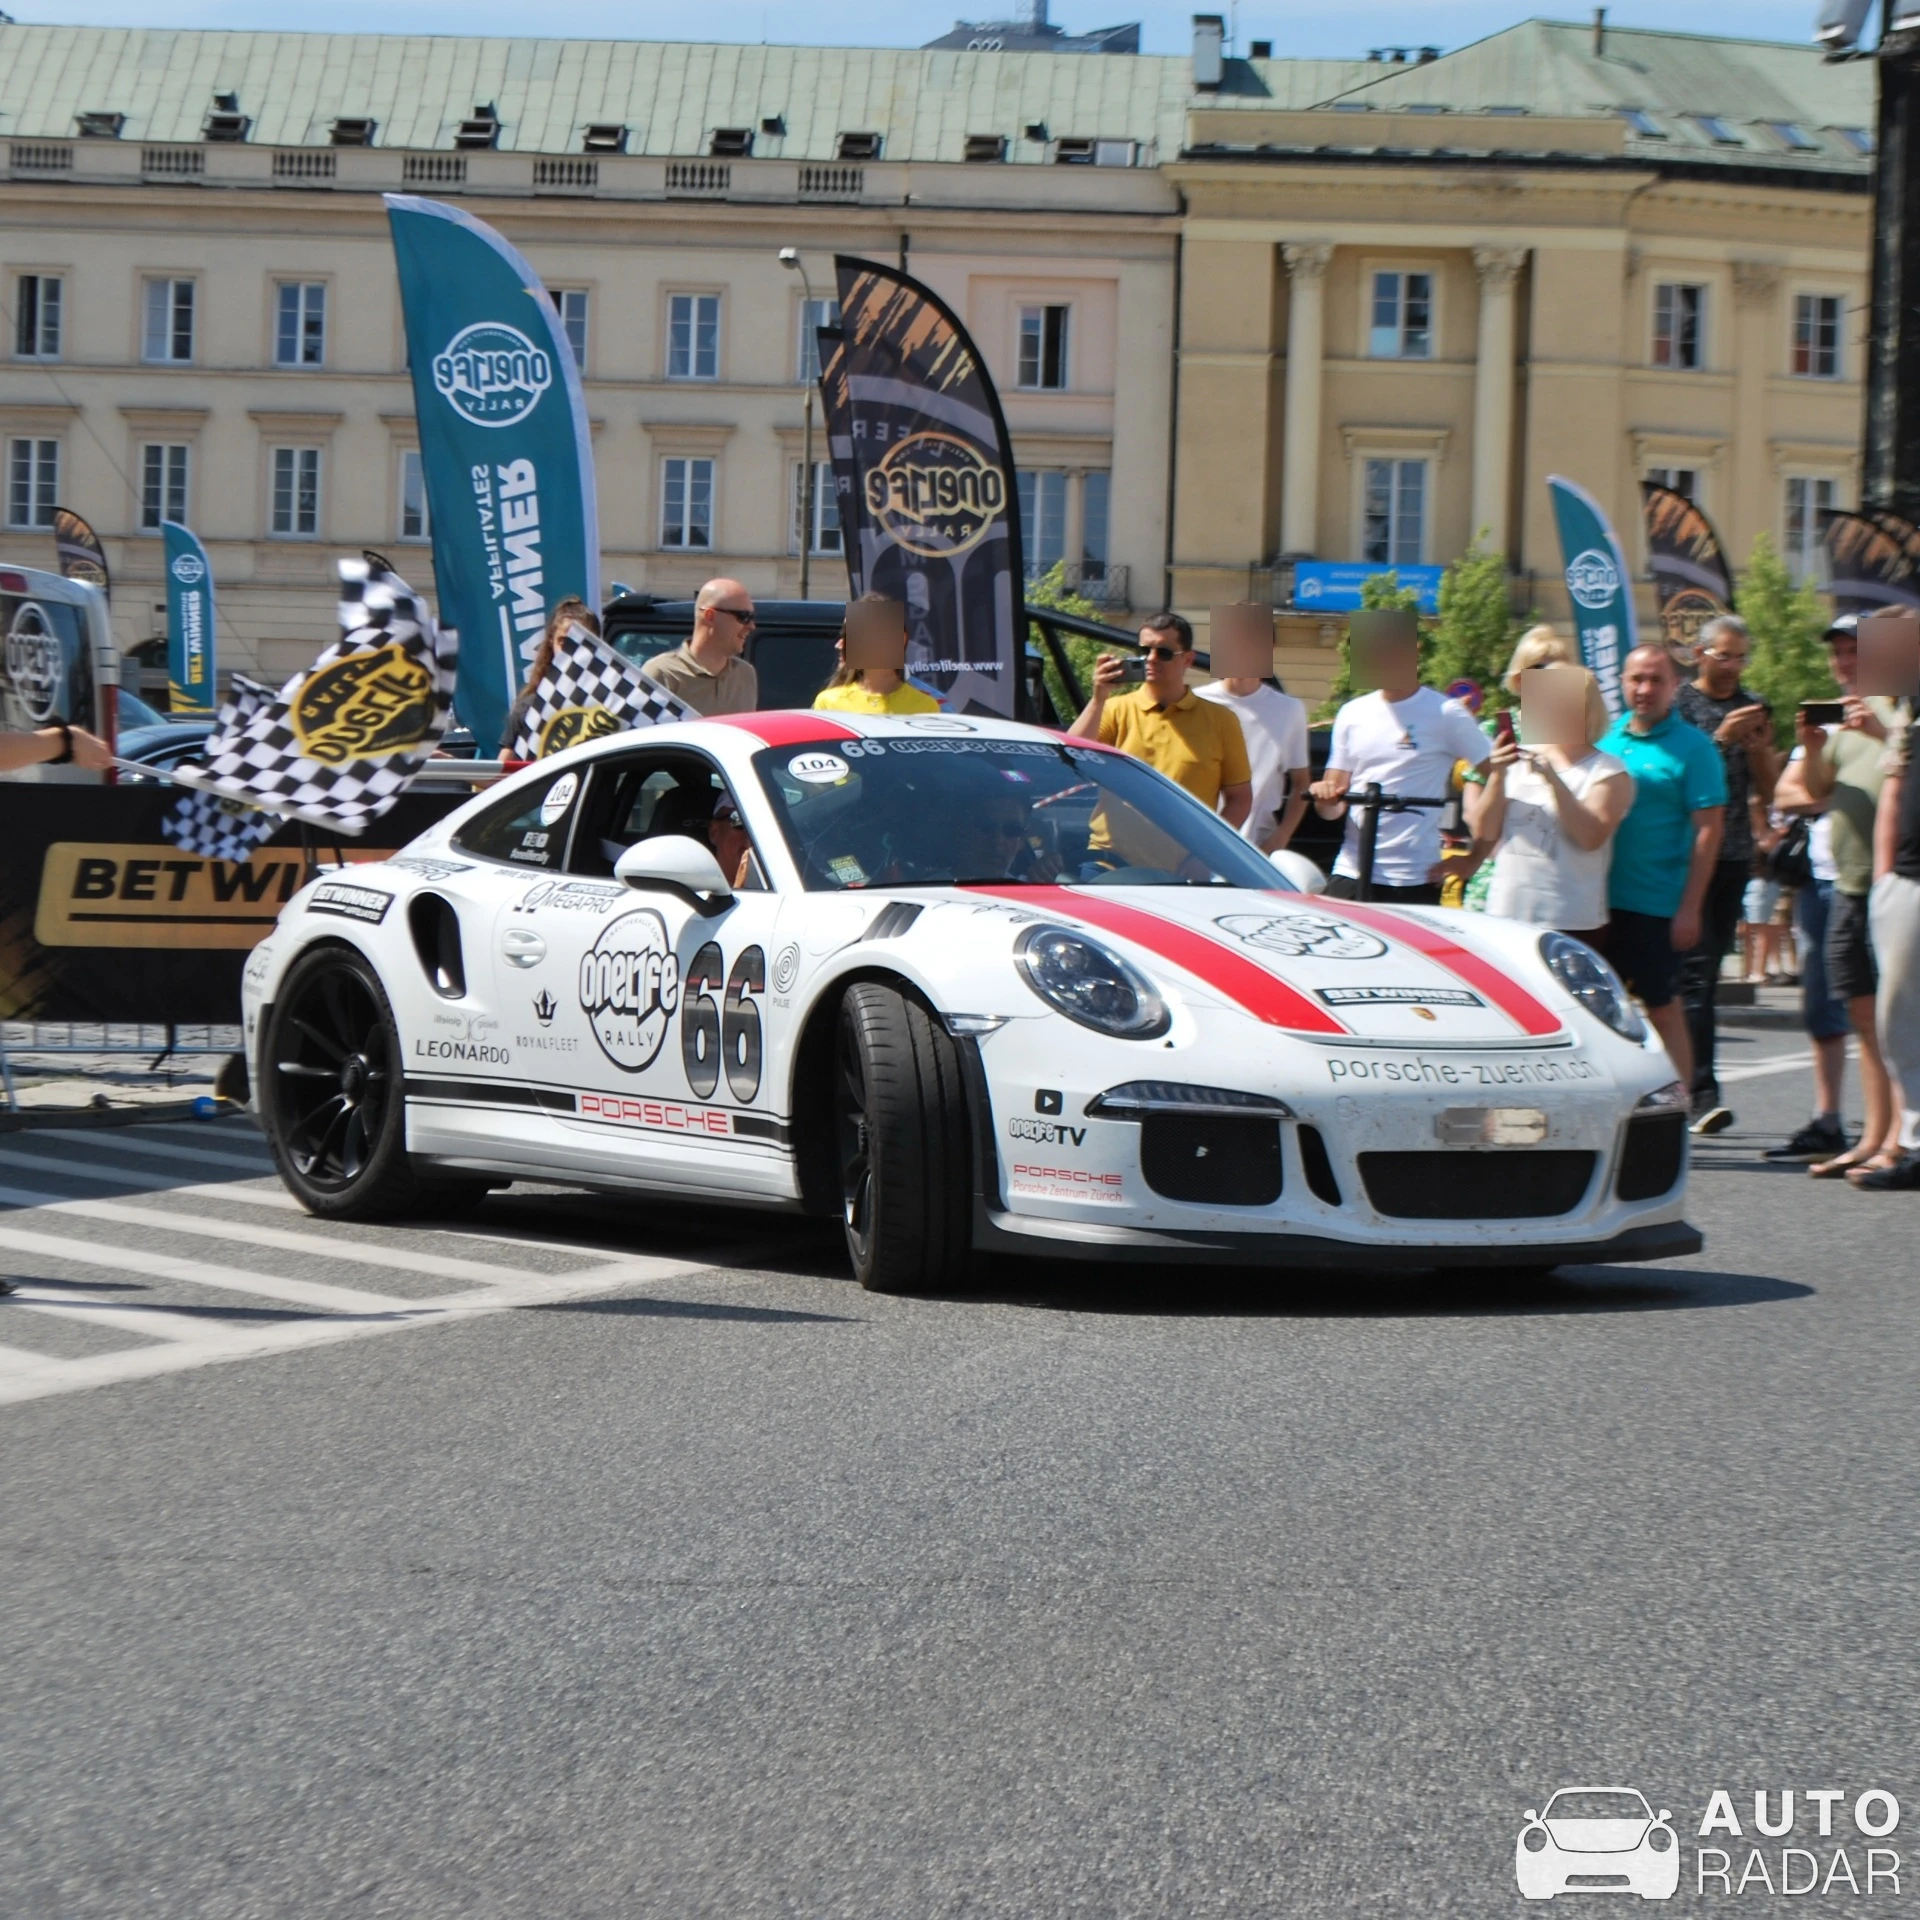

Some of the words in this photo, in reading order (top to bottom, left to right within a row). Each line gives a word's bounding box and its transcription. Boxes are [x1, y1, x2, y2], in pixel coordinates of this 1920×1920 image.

[841, 741, 886, 758] 66
[1064, 746, 1106, 764] 66
[797, 758, 838, 771] 104
[550, 784, 574, 802] 104
[314, 885, 390, 911] BETWINNER
[541, 893, 615, 914] MEGAPRO
[1322, 988, 1469, 1001] BETWINNER
[681, 940, 766, 1104] 66
[604, 1030, 655, 1048] RALLY
[415, 1039, 510, 1066] LEONARDO
[1326, 1056, 1601, 1085] porsche-zuerich.ch
[581, 1095, 728, 1134] PORSCHE
[1013, 1164, 1123, 1186] PORSCHE
[1013, 1179, 1048, 1195] Porsche
[1049, 1184, 1088, 1199] Zentrum
[1090, 1188, 1122, 1202] Zürich
